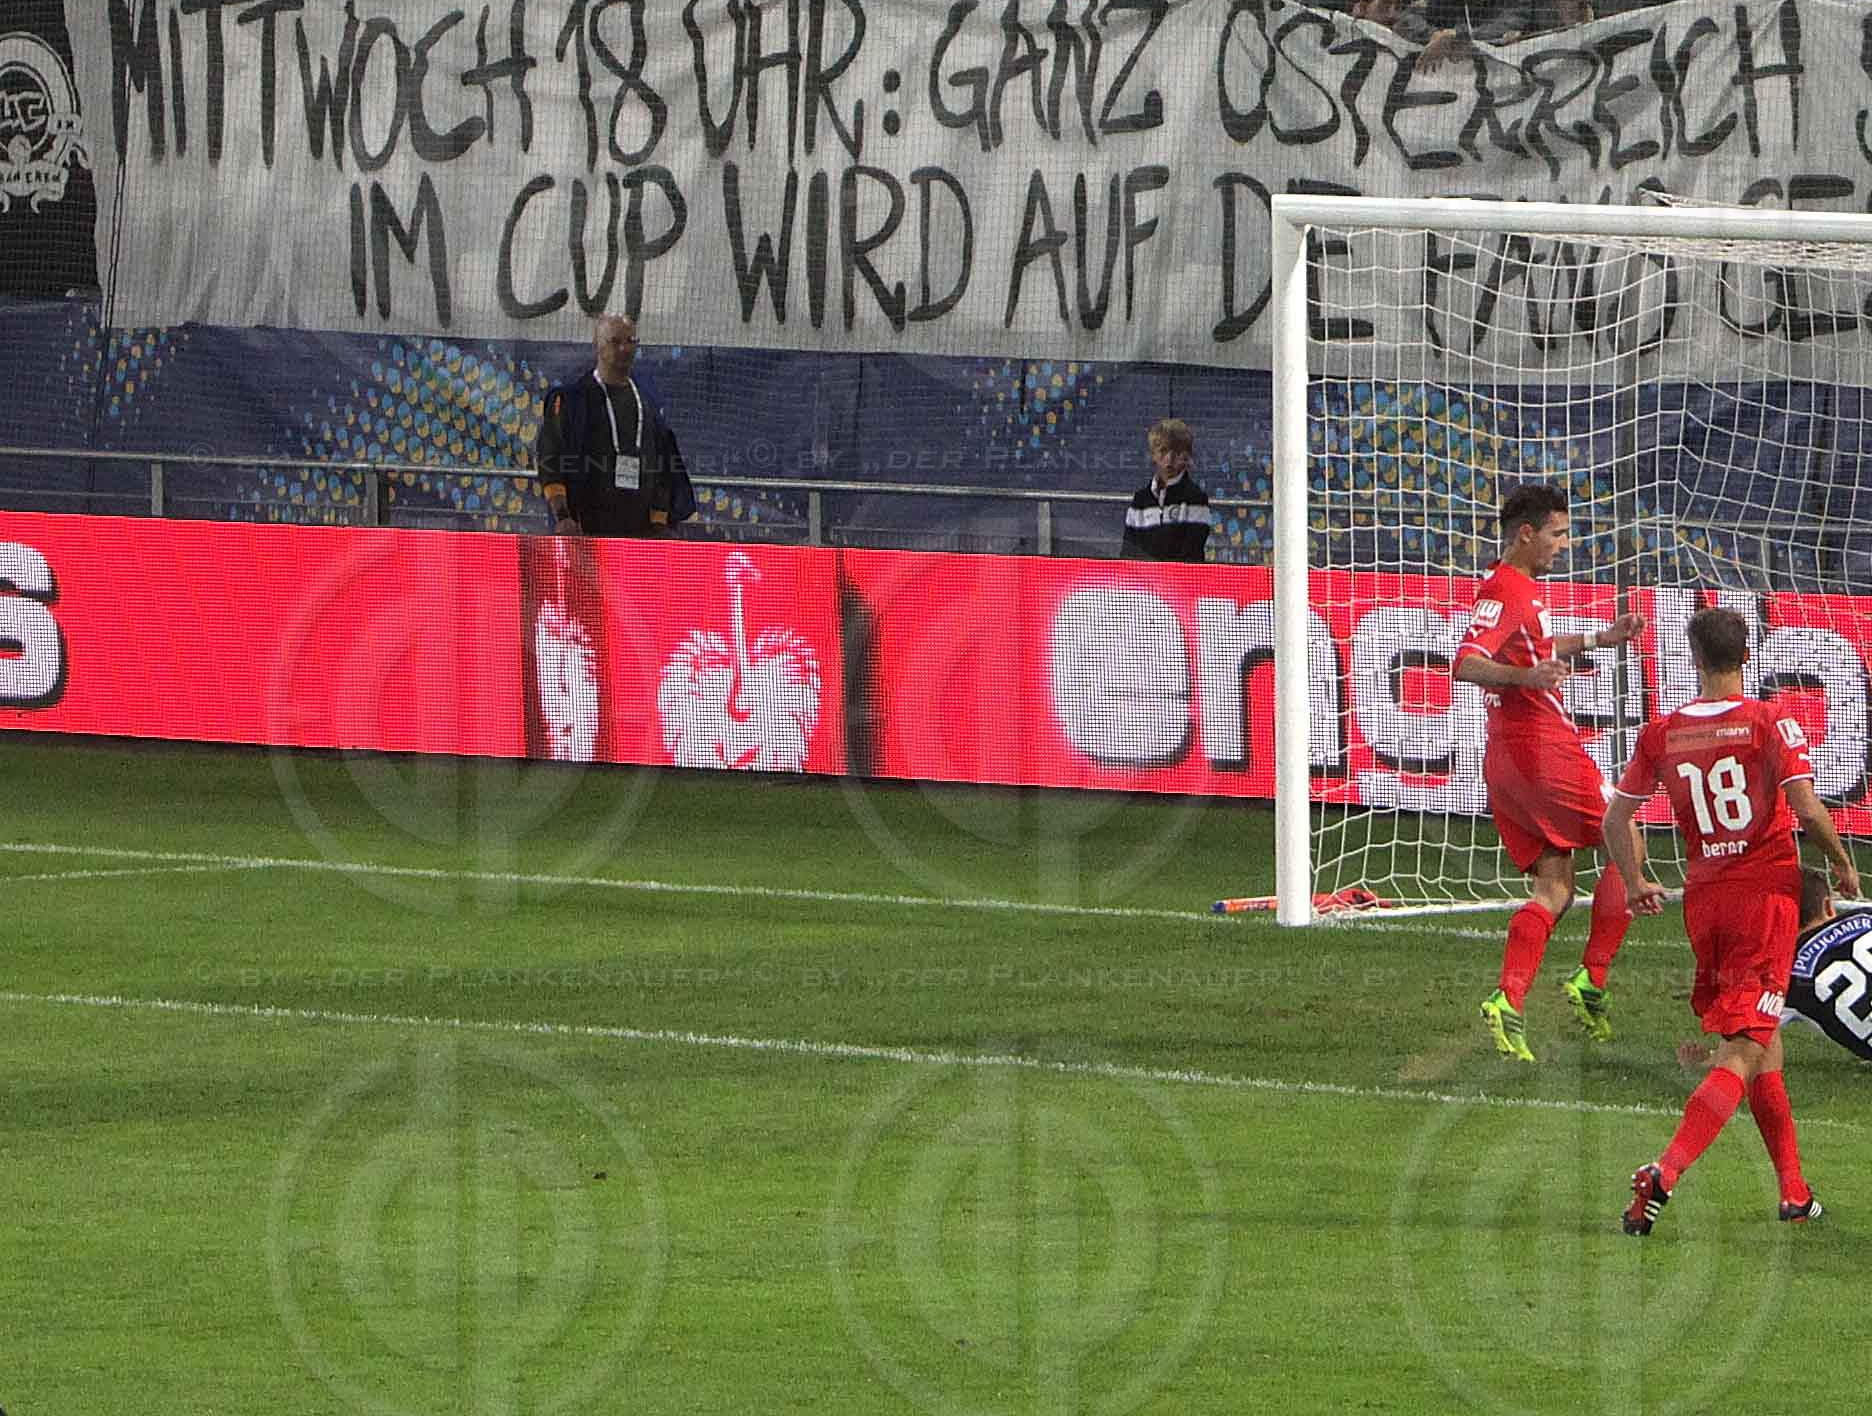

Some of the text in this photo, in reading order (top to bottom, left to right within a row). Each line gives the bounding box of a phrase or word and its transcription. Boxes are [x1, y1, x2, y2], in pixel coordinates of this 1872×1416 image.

[349, 174, 450, 329] IM
[494, 167, 688, 321] CUP
[725, 162, 976, 333] WIRD
[1009, 162, 1170, 331] AUF
[1213, 172, 1375, 343] DE
[1676, 755, 1754, 835] 18
